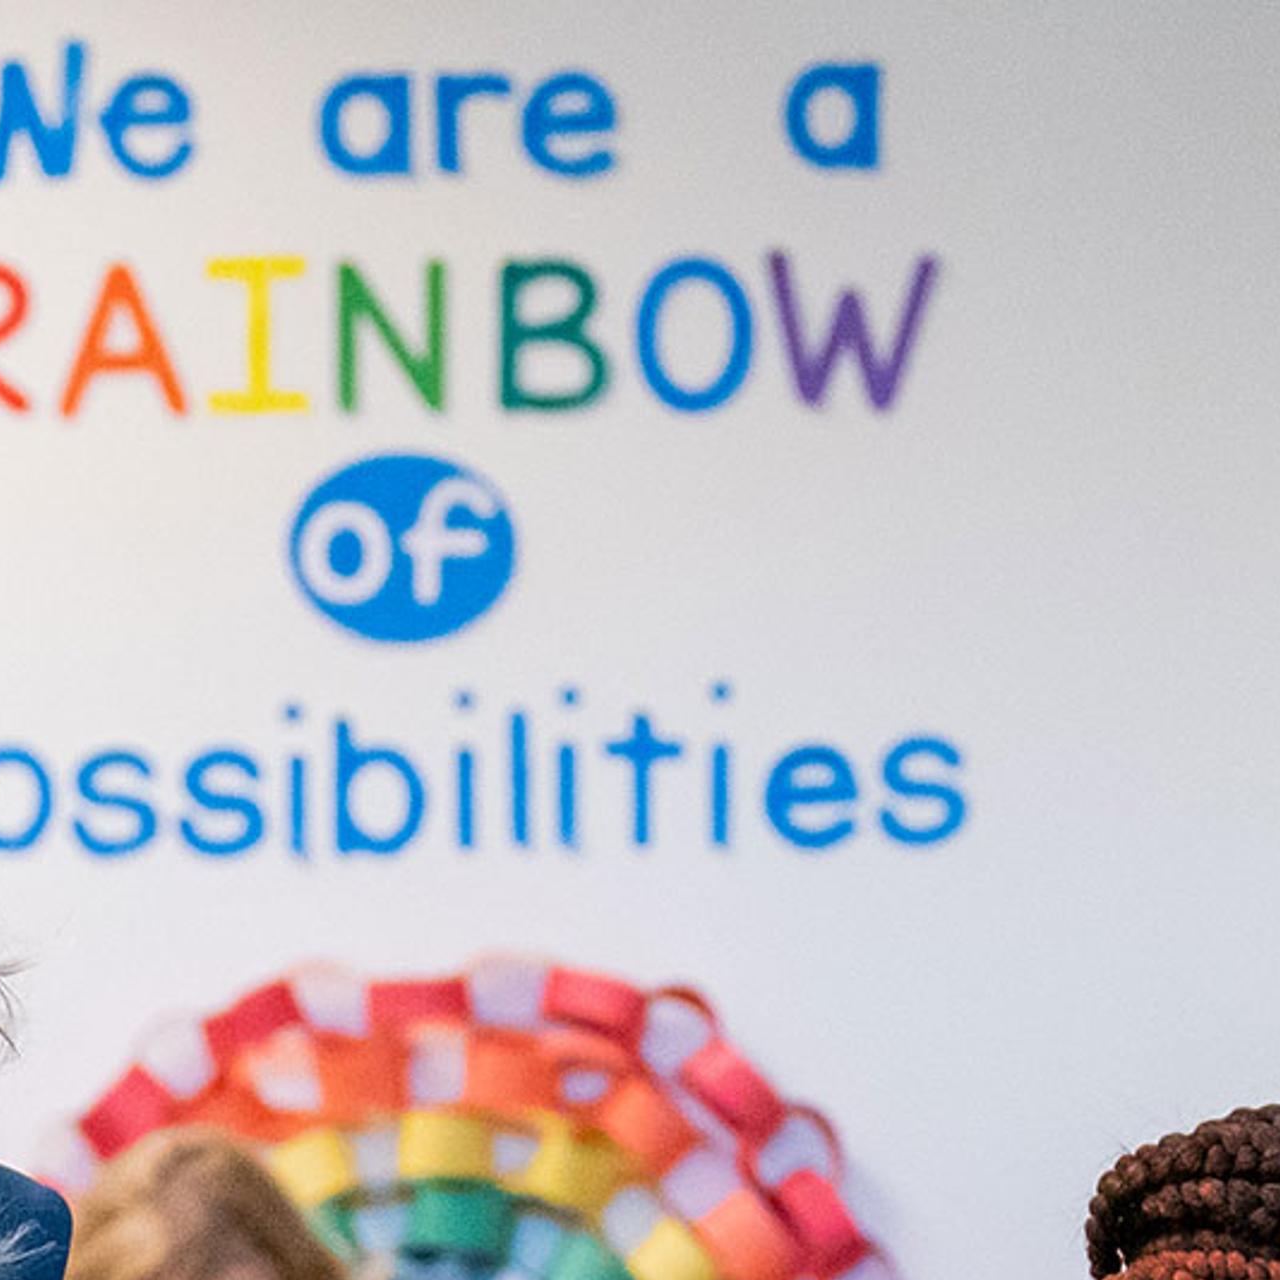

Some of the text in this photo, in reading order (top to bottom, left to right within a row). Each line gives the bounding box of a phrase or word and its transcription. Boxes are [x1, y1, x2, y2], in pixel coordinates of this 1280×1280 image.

[320, 71, 617, 179] are
[784, 63, 881, 173] a
[297, 475, 498, 606] of
